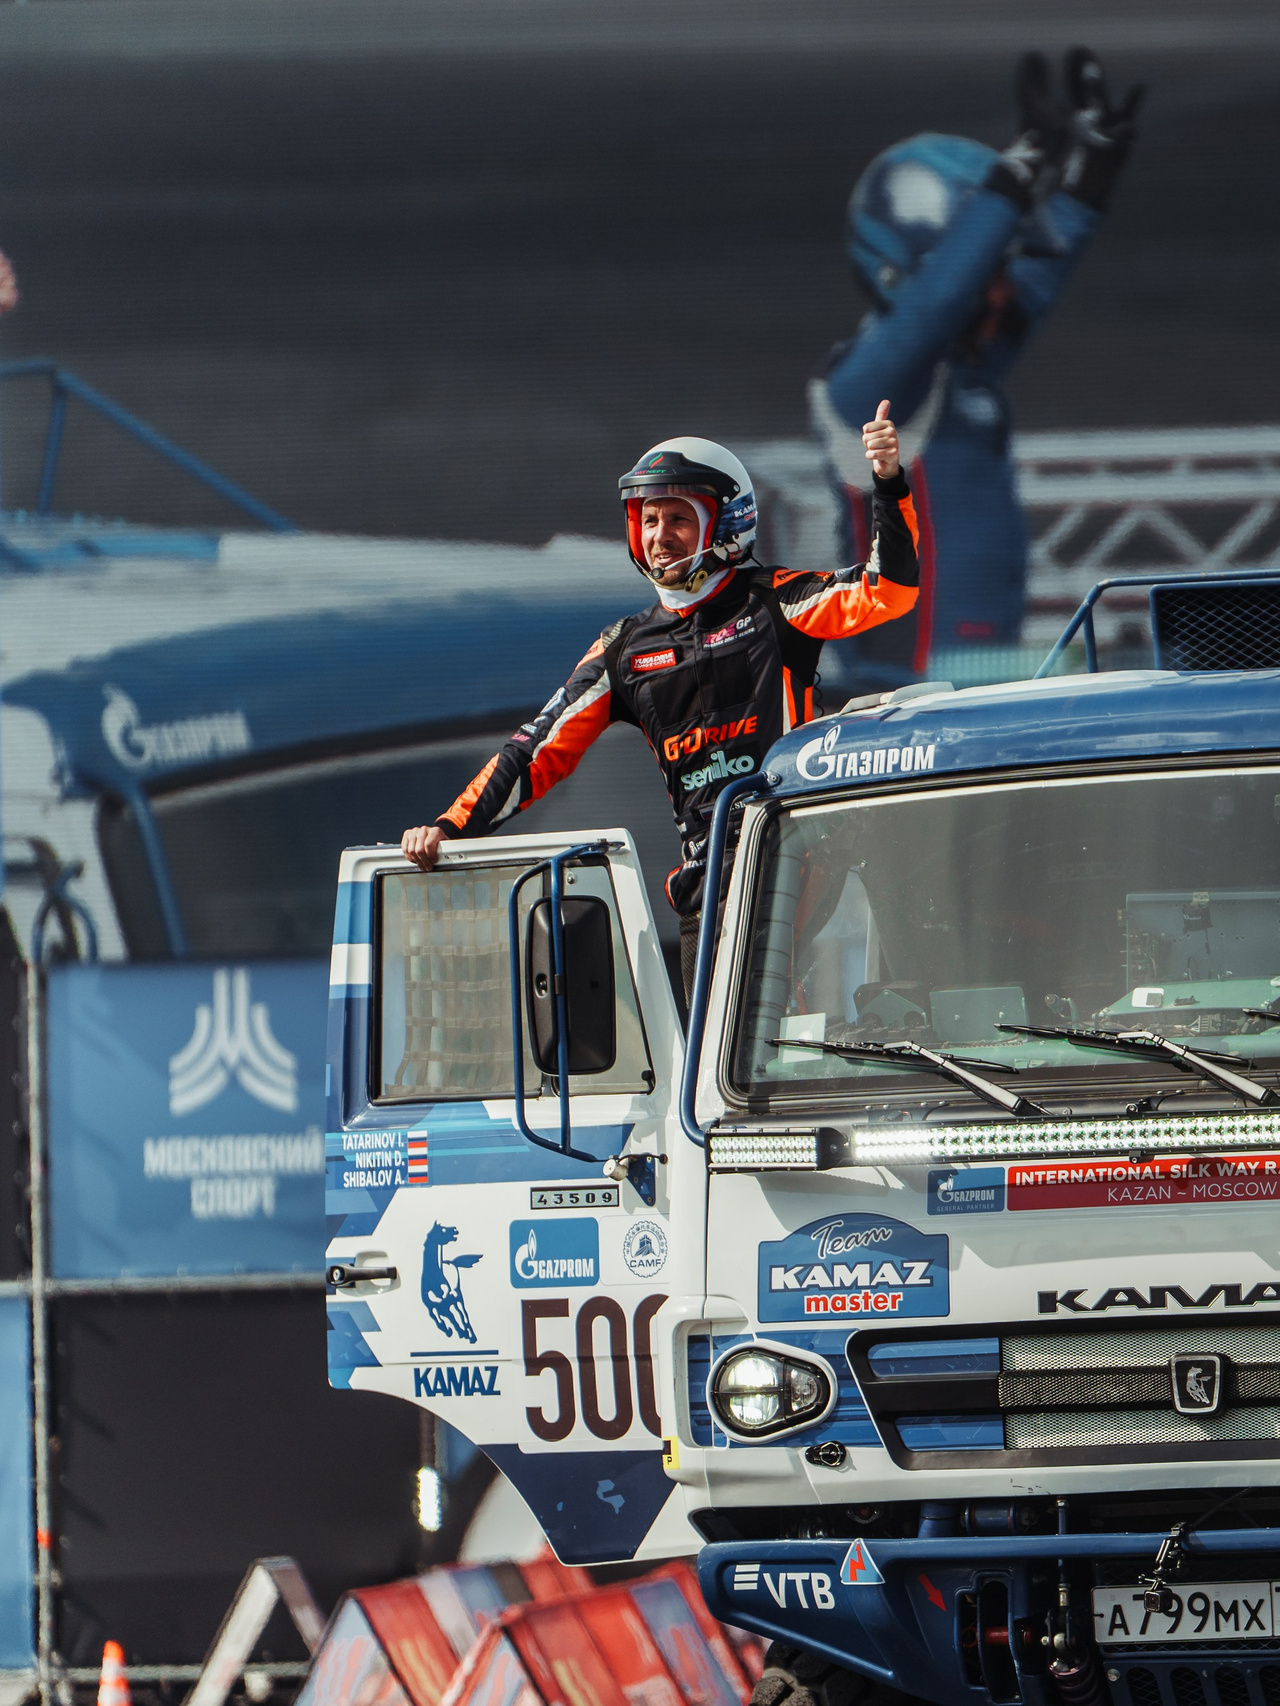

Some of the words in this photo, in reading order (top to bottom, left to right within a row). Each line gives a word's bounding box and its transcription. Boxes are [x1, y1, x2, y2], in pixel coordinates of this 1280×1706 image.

[736, 616, 752, 630] GP
[835, 745, 935, 778] ГАЗПРОМ
[341, 1132, 396, 1150] TATARINOV
[398, 1132, 404, 1147] I.
[355, 1150, 392, 1168] NIKITIN
[394, 1150, 405, 1166] D.
[343, 1169, 392, 1188] SHIBALOV
[394, 1169, 405, 1185] A.
[1015, 1164, 1166, 1186] INTERNATIONAL
[1170, 1163, 1210, 1179] SILK
[1216, 1161, 1260, 1176] WAY
[537, 1192, 613, 1205] 43509
[953, 1189, 995, 1202] GAZPROM
[1107, 1186, 1172, 1202] KAZAN
[1192, 1181, 1278, 1200] MOSCOW
[966, 1203, 995, 1211] PARTNER
[811, 1220, 892, 1259] Team
[538, 1258, 595, 1279] GAZPROM
[629, 1259, 662, 1268] CAMF
[771, 1261, 931, 1290] KAMAZ
[804, 1290, 903, 1314] master
[413, 1366, 501, 1397] KAMAZ
[765, 1571, 836, 1609] VTB
